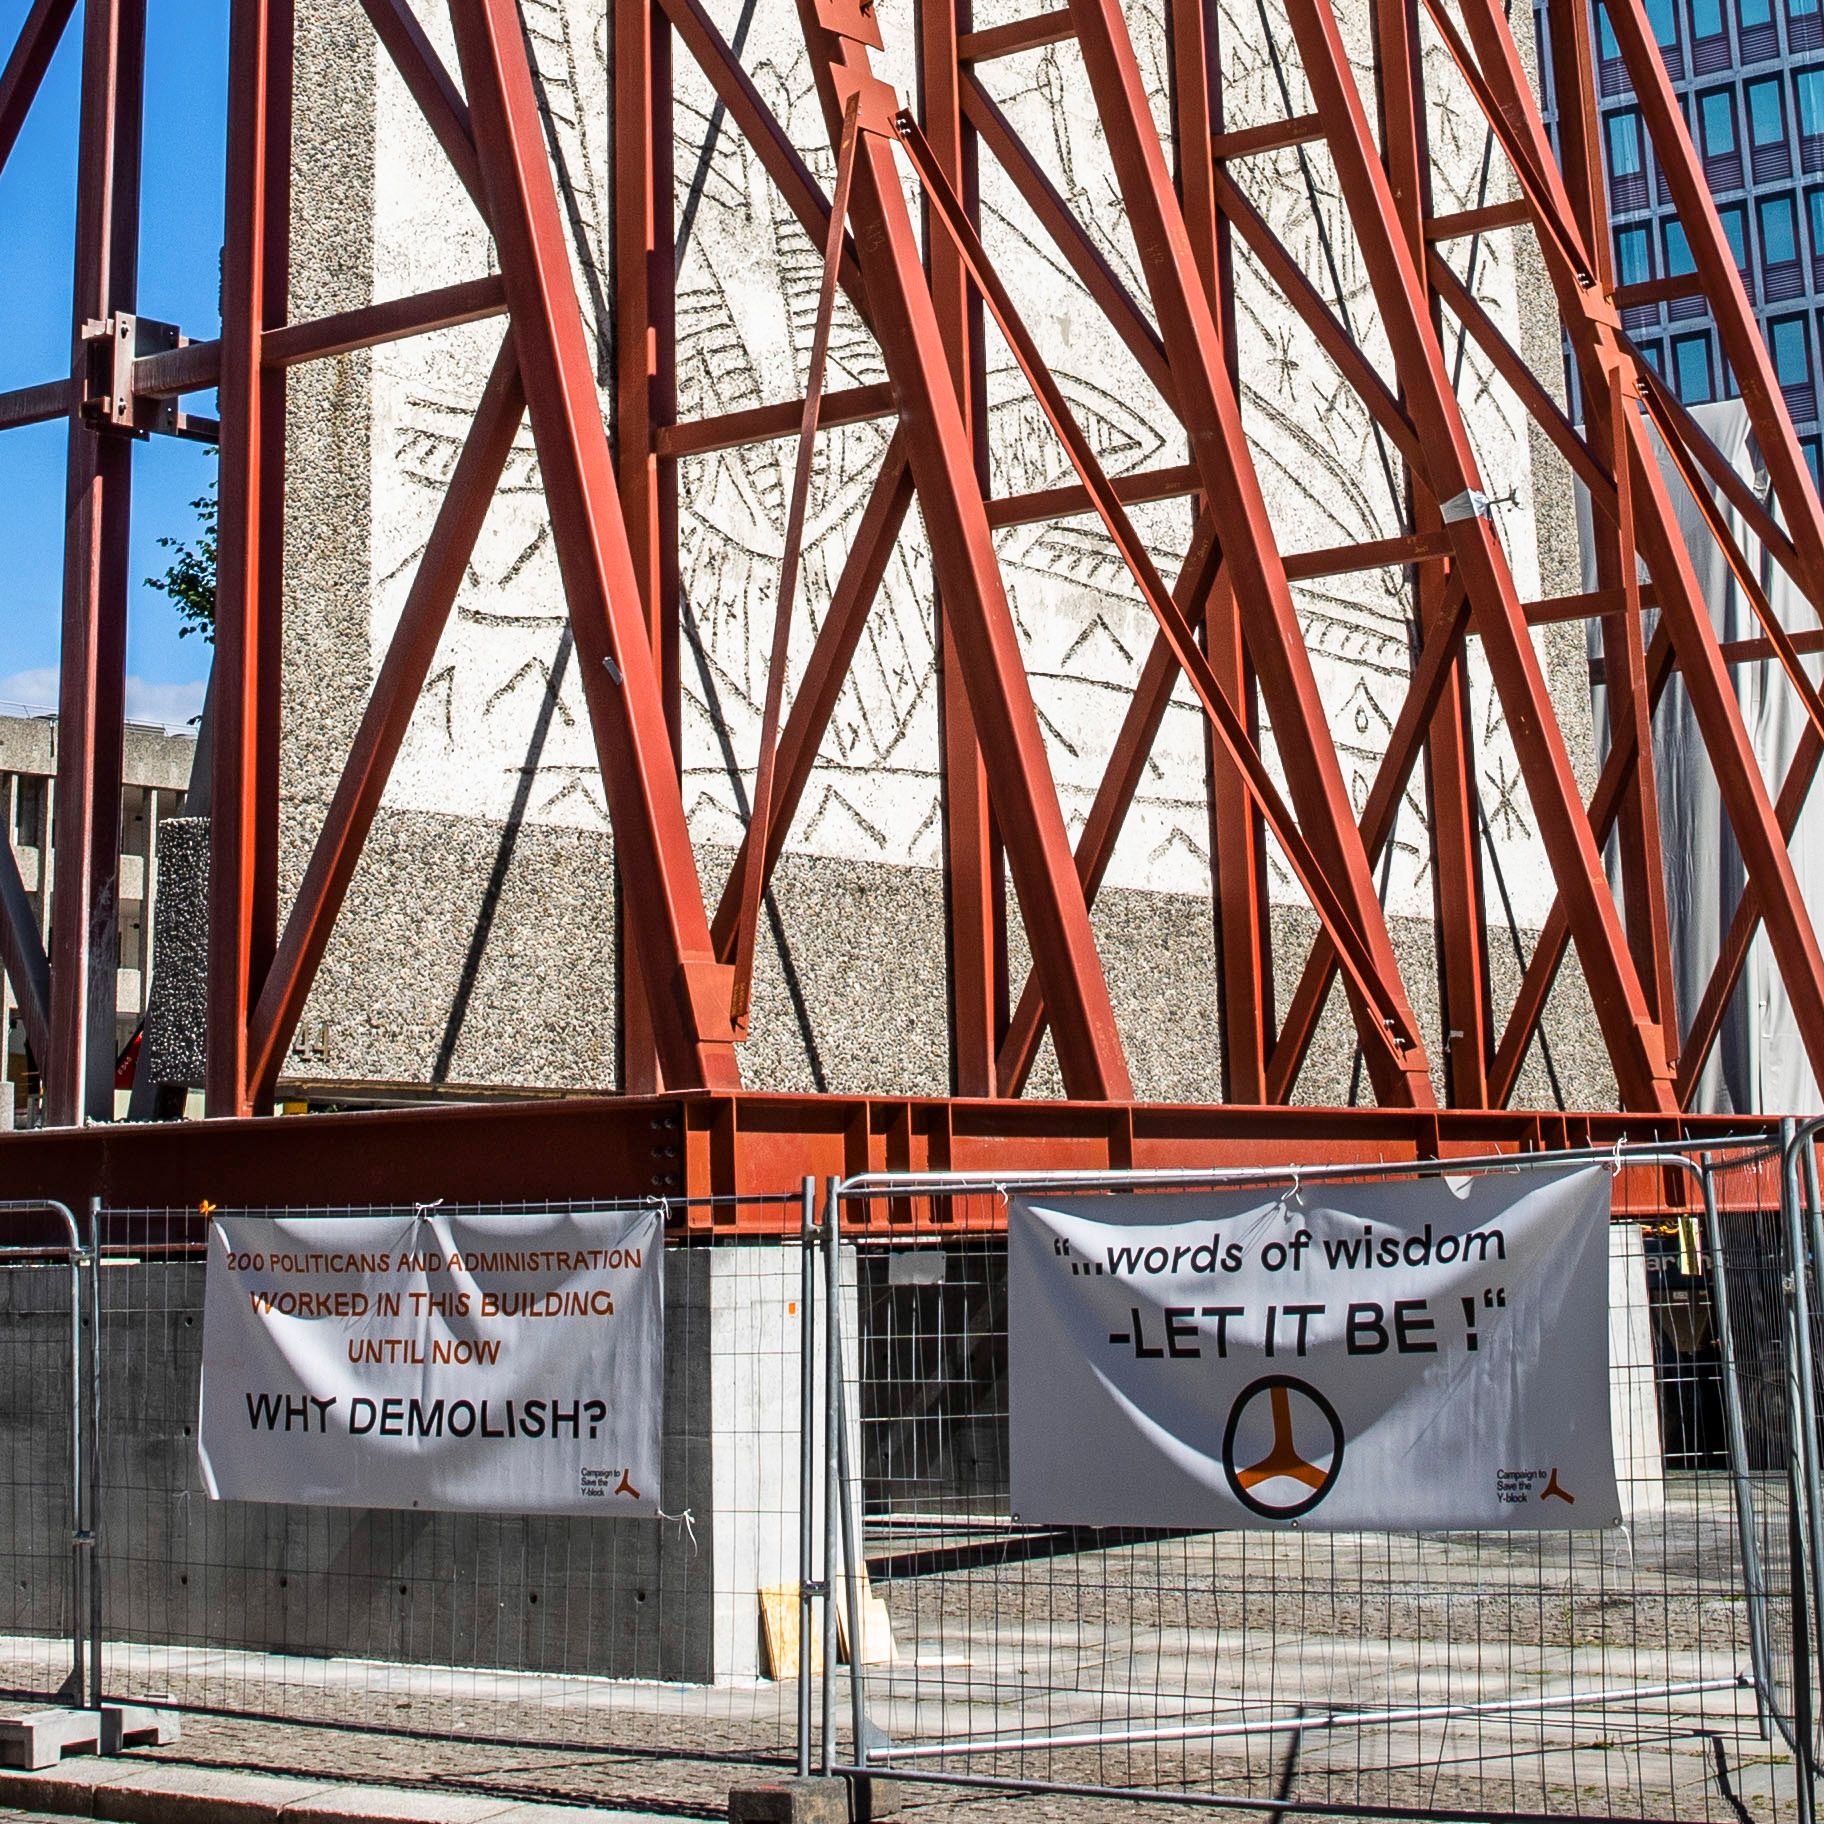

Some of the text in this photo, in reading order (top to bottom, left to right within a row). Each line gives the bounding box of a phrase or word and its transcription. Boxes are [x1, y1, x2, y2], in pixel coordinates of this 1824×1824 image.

[1260, 1229, 1314, 1272] of
[1323, 1224, 1507, 1270] wisdom
[226, 1248, 642, 1273] 200 POLITICANS AND ADMINISTRATION
[249, 1290, 614, 1318] WORKED IN THIS BUILDING
[1264, 1304, 1326, 1358] IT
[1345, 1298, 1438, 1356] BE
[348, 1339, 501, 1366] UNTIL NOW
[246, 1392, 607, 1439] WHY DEMOLISH?
[581, 1467, 621, 1479] Campaign to
[581, 1477, 608, 1487] Save the
[1496, 1468, 1547, 1482] Campaign to
[581, 1487, 605, 1497] Y-block
[1496, 1480, 1532, 1491] Save the
[1496, 1492, 1528, 1503] Y-block
